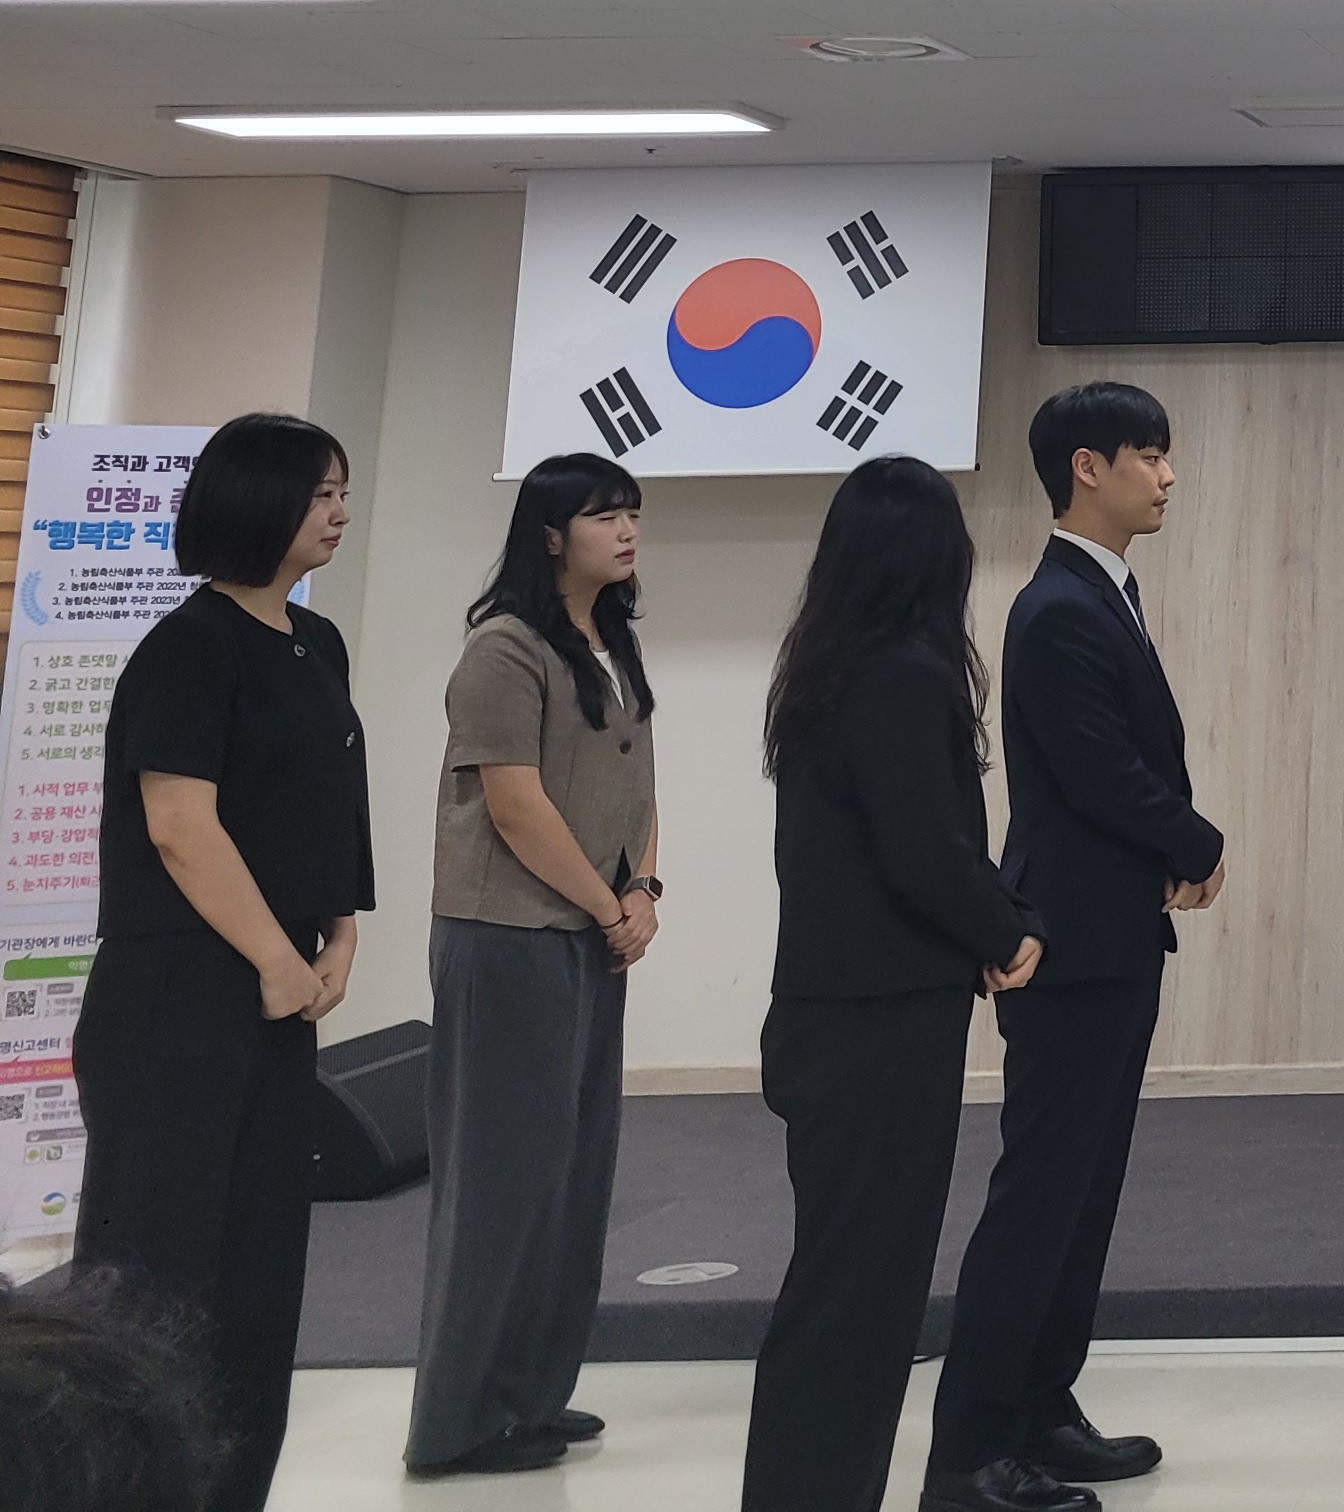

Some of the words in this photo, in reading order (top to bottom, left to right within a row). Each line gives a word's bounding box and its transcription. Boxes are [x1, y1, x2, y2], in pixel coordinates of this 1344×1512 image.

[91, 454, 149, 472] 조직과
[86, 486, 162, 513] 인정과
[47, 655, 74, 669] 상호
